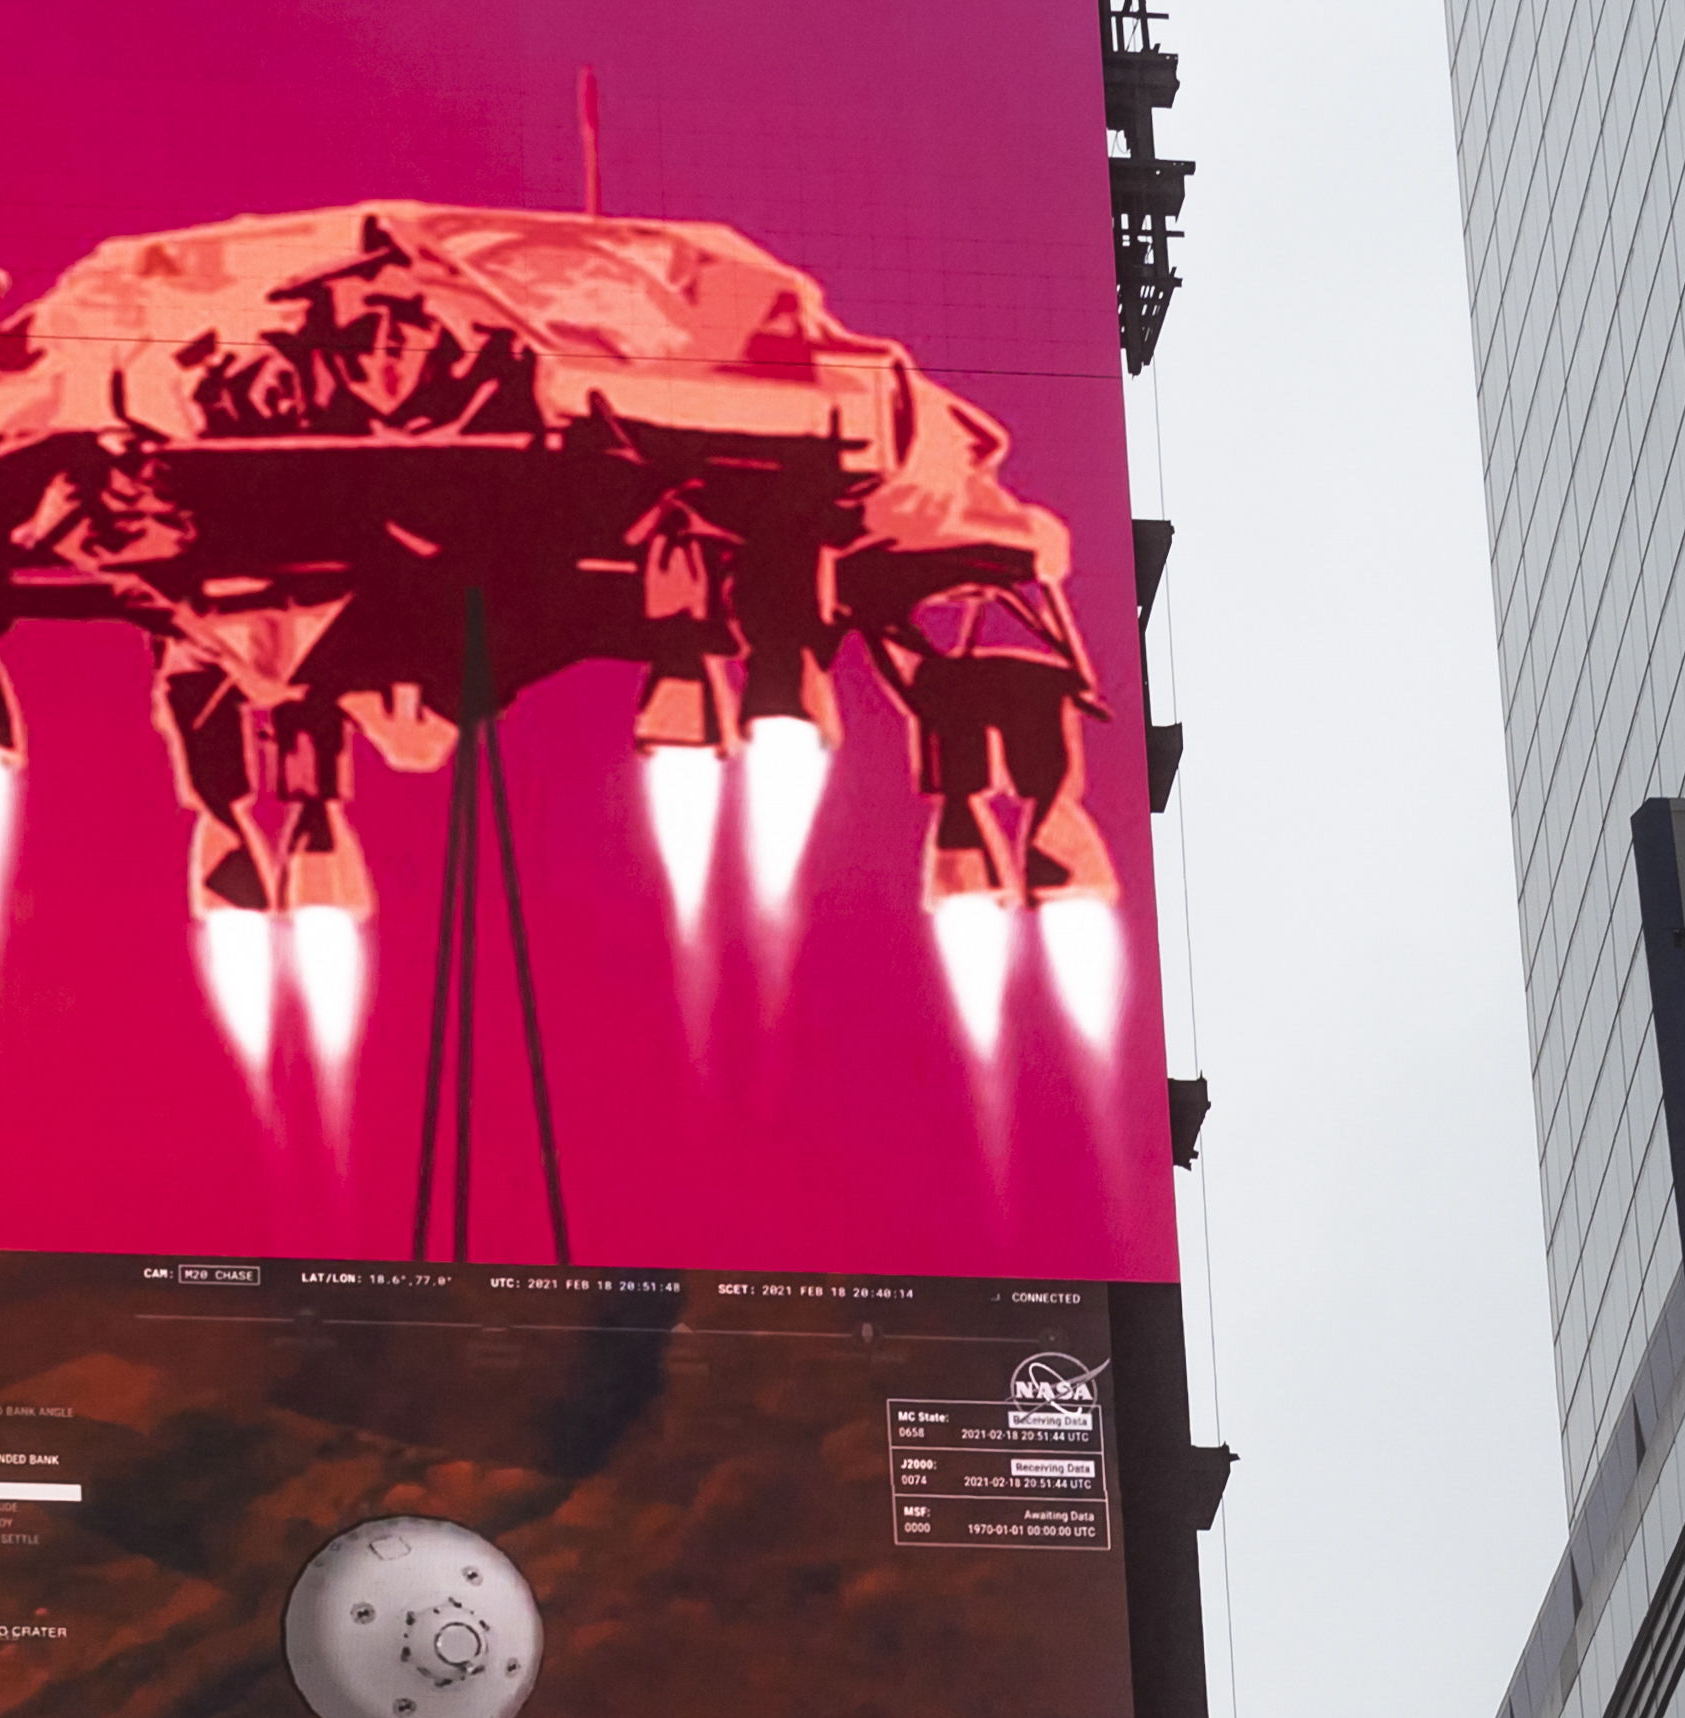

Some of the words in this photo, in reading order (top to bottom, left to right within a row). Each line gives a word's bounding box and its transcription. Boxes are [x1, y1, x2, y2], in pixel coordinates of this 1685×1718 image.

[144, 1268, 174, 1279] CAM:
[184, 1269, 208, 1280] M20
[215, 1270, 253, 1282] CHASE
[301, 1272, 362, 1284] LAT/LON:
[490, 1278, 520, 1288] UTC:
[528, 1278, 558, 1290] 2021
[566, 1280, 590, 1290] FEB
[597, 1280, 612, 1291] 18
[718, 1284, 755, 1295] SCET:
[762, 1285, 792, 1296] 2021
[800, 1286, 824, 1297] FEB
[831, 1286, 846, 1298] 18
[853, 1286, 914, 1299] 20:40:14
[1012, 1292, 1081, 1305] CONNECTED
[1016, 1381, 1093, 1401] NASA
[898, 1411, 916, 1422] MC
[918, 1412, 949, 1423] State:
[1065, 1416, 1087, 1426] Data
[898, 1427, 925, 1438] 0658
[961, 1428, 1018, 1440] 2021-02-18
[1067, 1432, 1089, 1442] UTC
[29, 1454, 59, 1466] BANK
[900, 1459, 937, 1470] J2000:
[1016, 1463, 1064, 1475] Receiving
[1067, 1464, 1090, 1474] Data
[901, 1475, 928, 1486] 0074
[964, 1476, 1021, 1488] 2021-02-18
[1070, 1479, 1092, 1490] UTC
[904, 1506, 930, 1517] MSF:
[1024, 1509, 1069, 1523] Awaiting
[1071, 1511, 1095, 1522] Data
[904, 1522, 931, 1533] 0000
[968, 1524, 1024, 1536] 1970-01-01
[1074, 1527, 1096, 1537] UTC
[11, 1625, 68, 1639] CRATER
